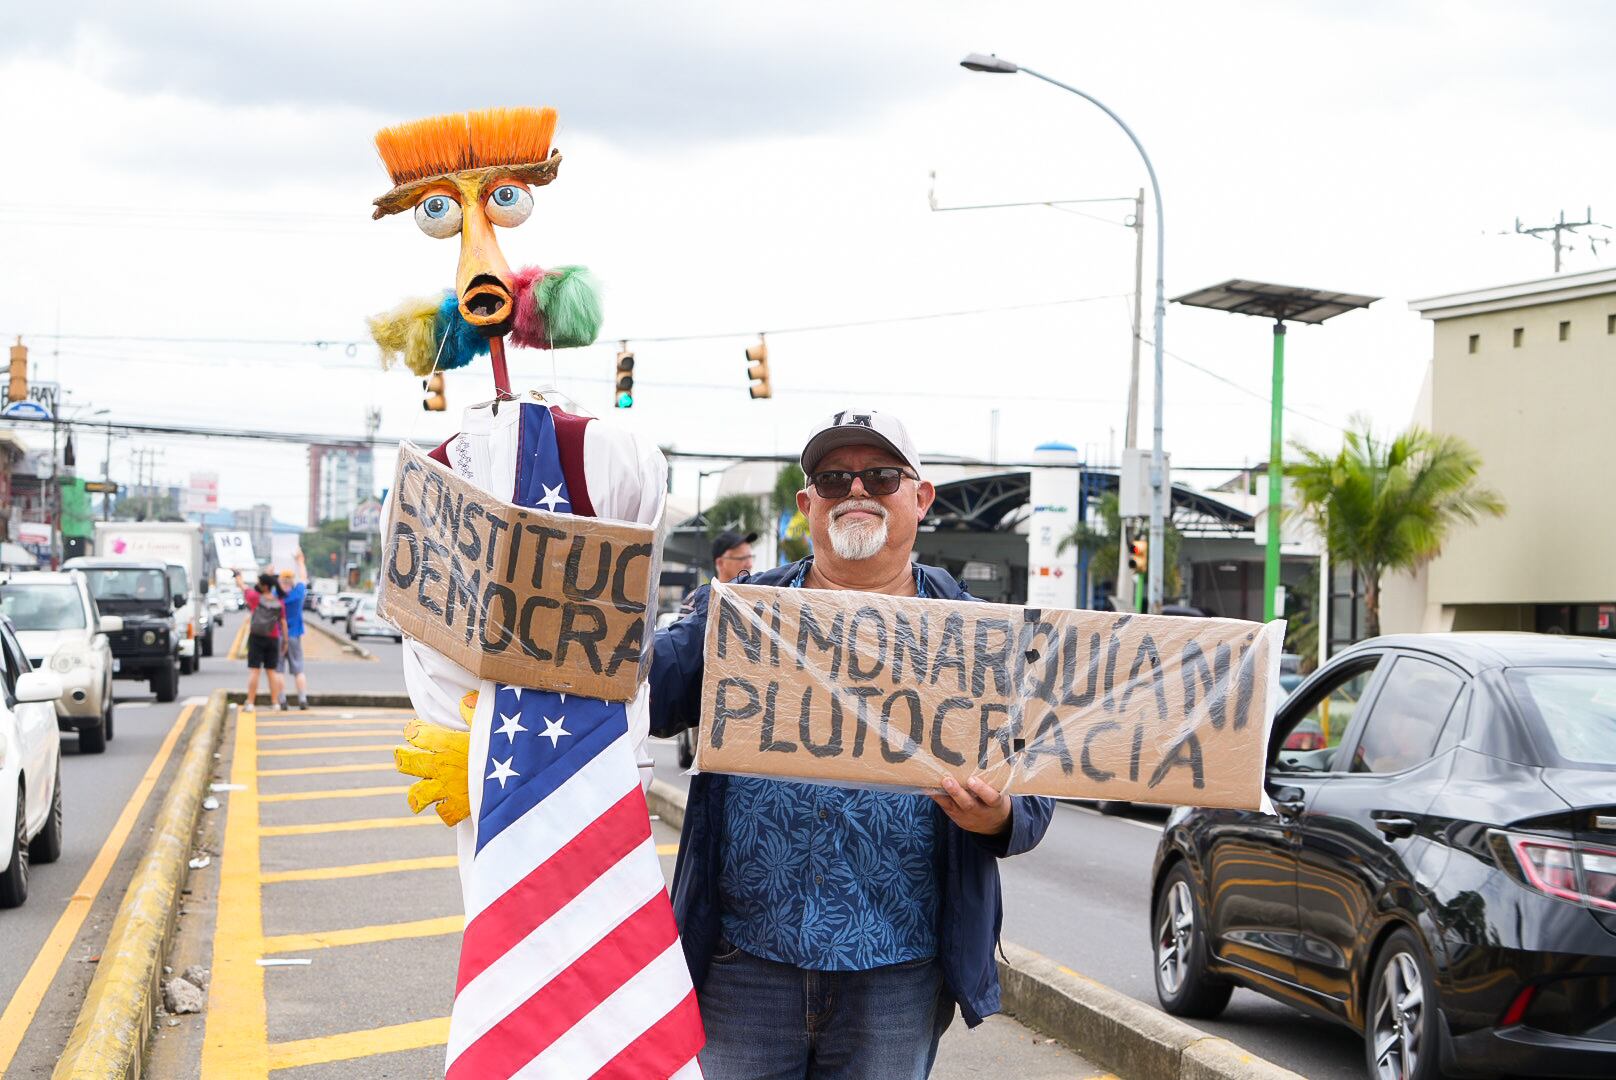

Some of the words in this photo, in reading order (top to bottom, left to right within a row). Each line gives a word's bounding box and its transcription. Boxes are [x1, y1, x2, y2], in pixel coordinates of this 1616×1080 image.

[716, 596, 780, 668] NI
[1181, 633, 1257, 731] NI
[710, 677, 1205, 789] PLUTOCRACIA
